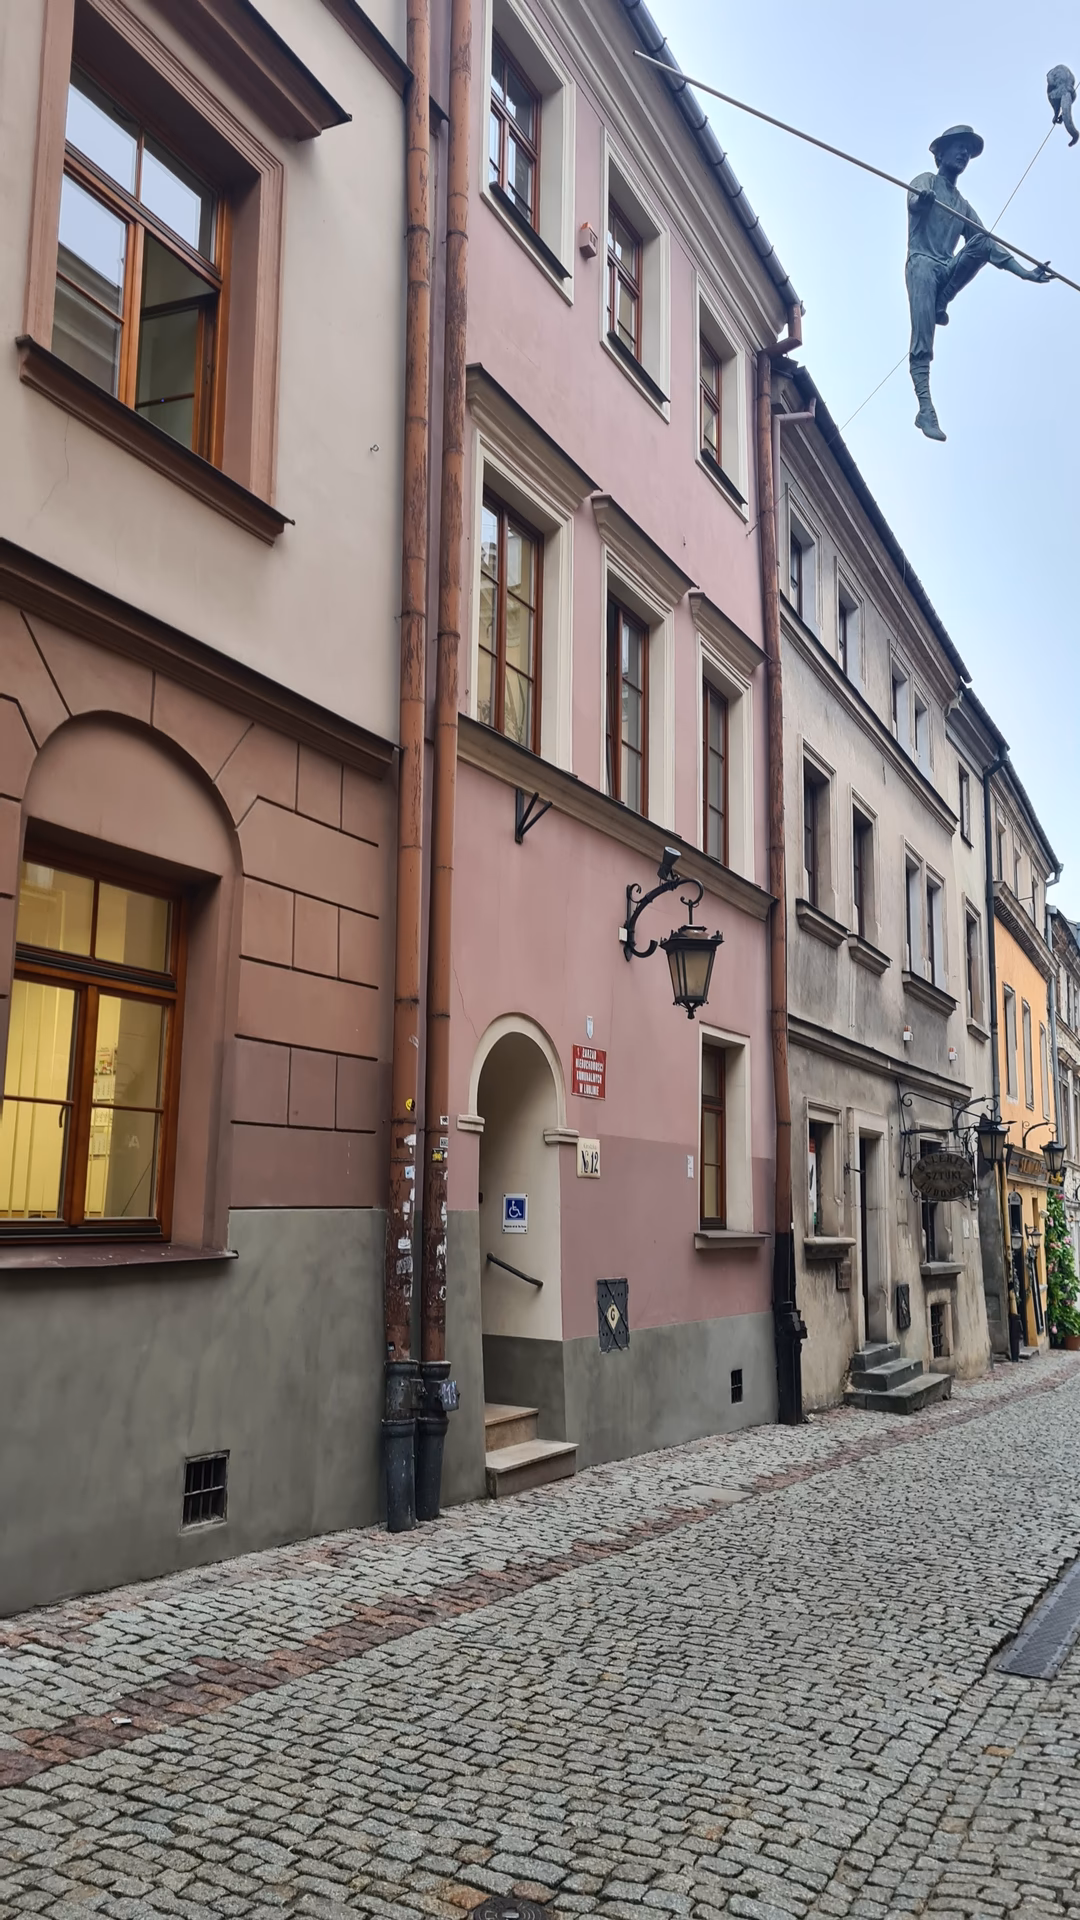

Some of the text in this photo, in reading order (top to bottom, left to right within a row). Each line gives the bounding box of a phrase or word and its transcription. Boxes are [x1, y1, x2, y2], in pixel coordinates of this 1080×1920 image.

[590, 1151, 599, 1173] 12
[917, 1154, 965, 1171] GALERIA
[925, 1171, 961, 1180] SZTUKI
[920, 1181, 969, 1197] LUDOWEJ
[610, 1308, 616, 1321] G
